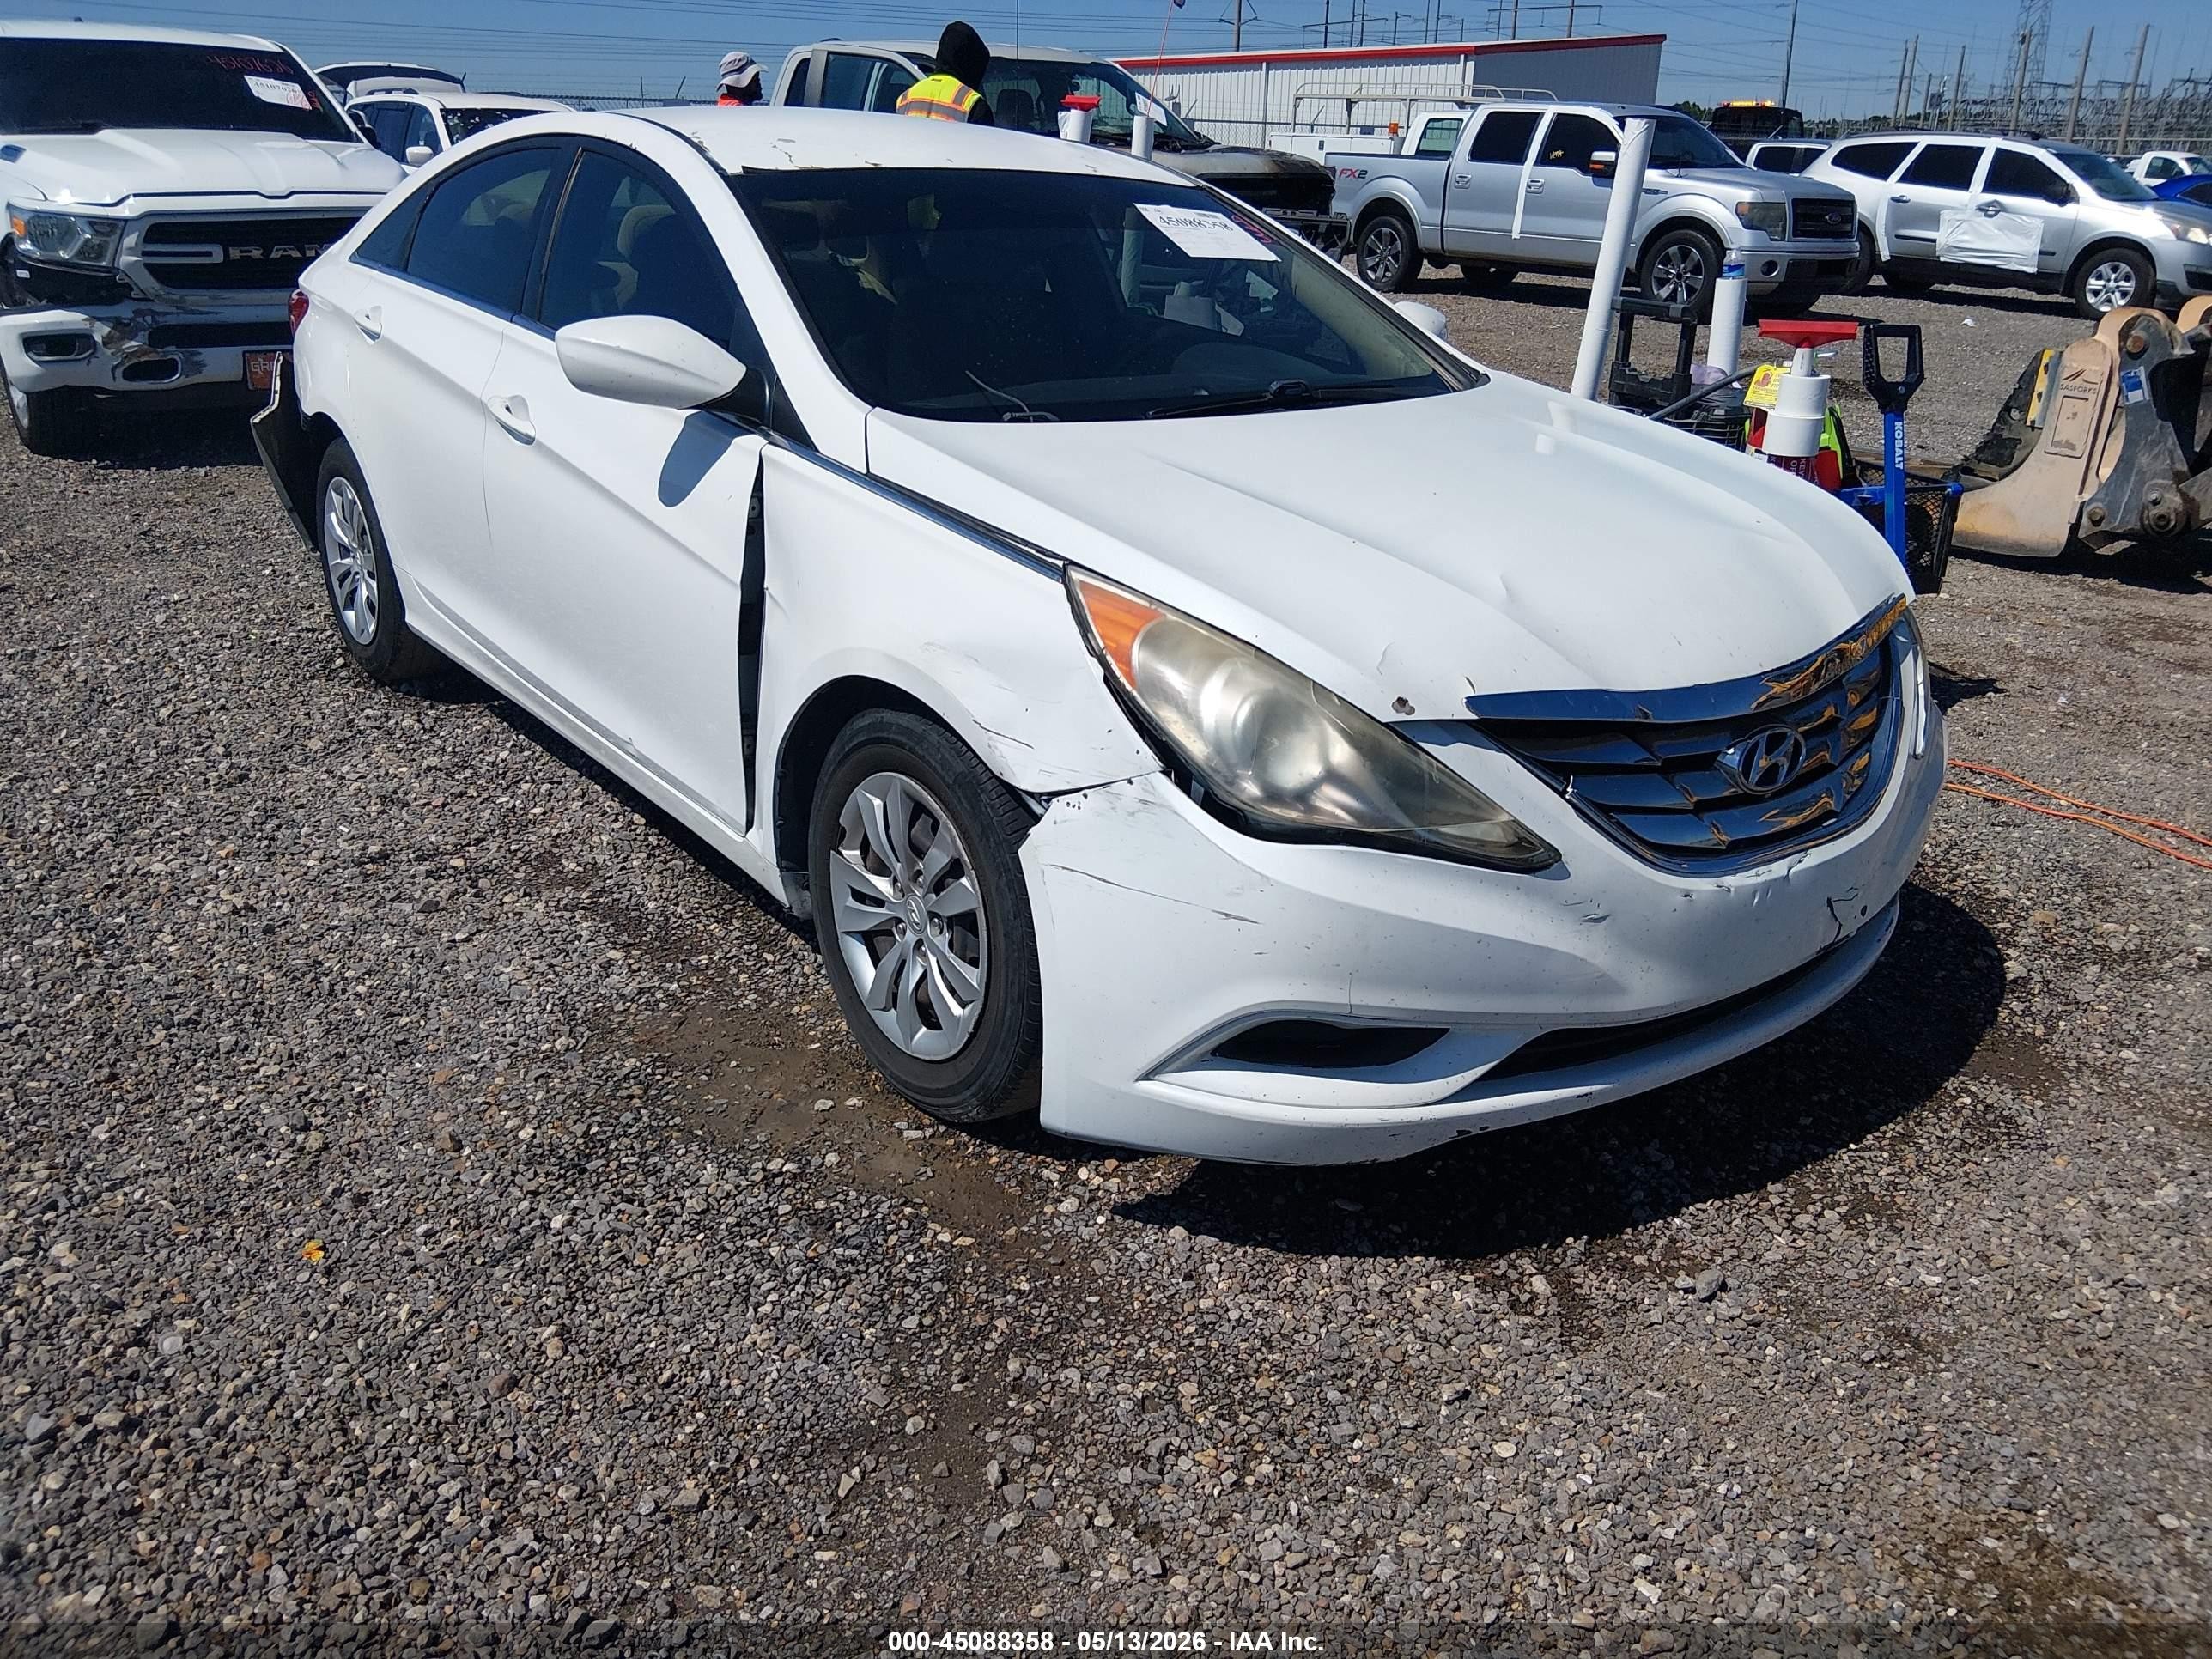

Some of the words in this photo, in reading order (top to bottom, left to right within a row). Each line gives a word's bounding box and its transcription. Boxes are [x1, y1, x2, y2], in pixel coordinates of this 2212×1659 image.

[1339, 168, 1368, 179] FX2
[1159, 216, 1234, 232] 45088358
[1894, 421, 1904, 470] KOBALT
